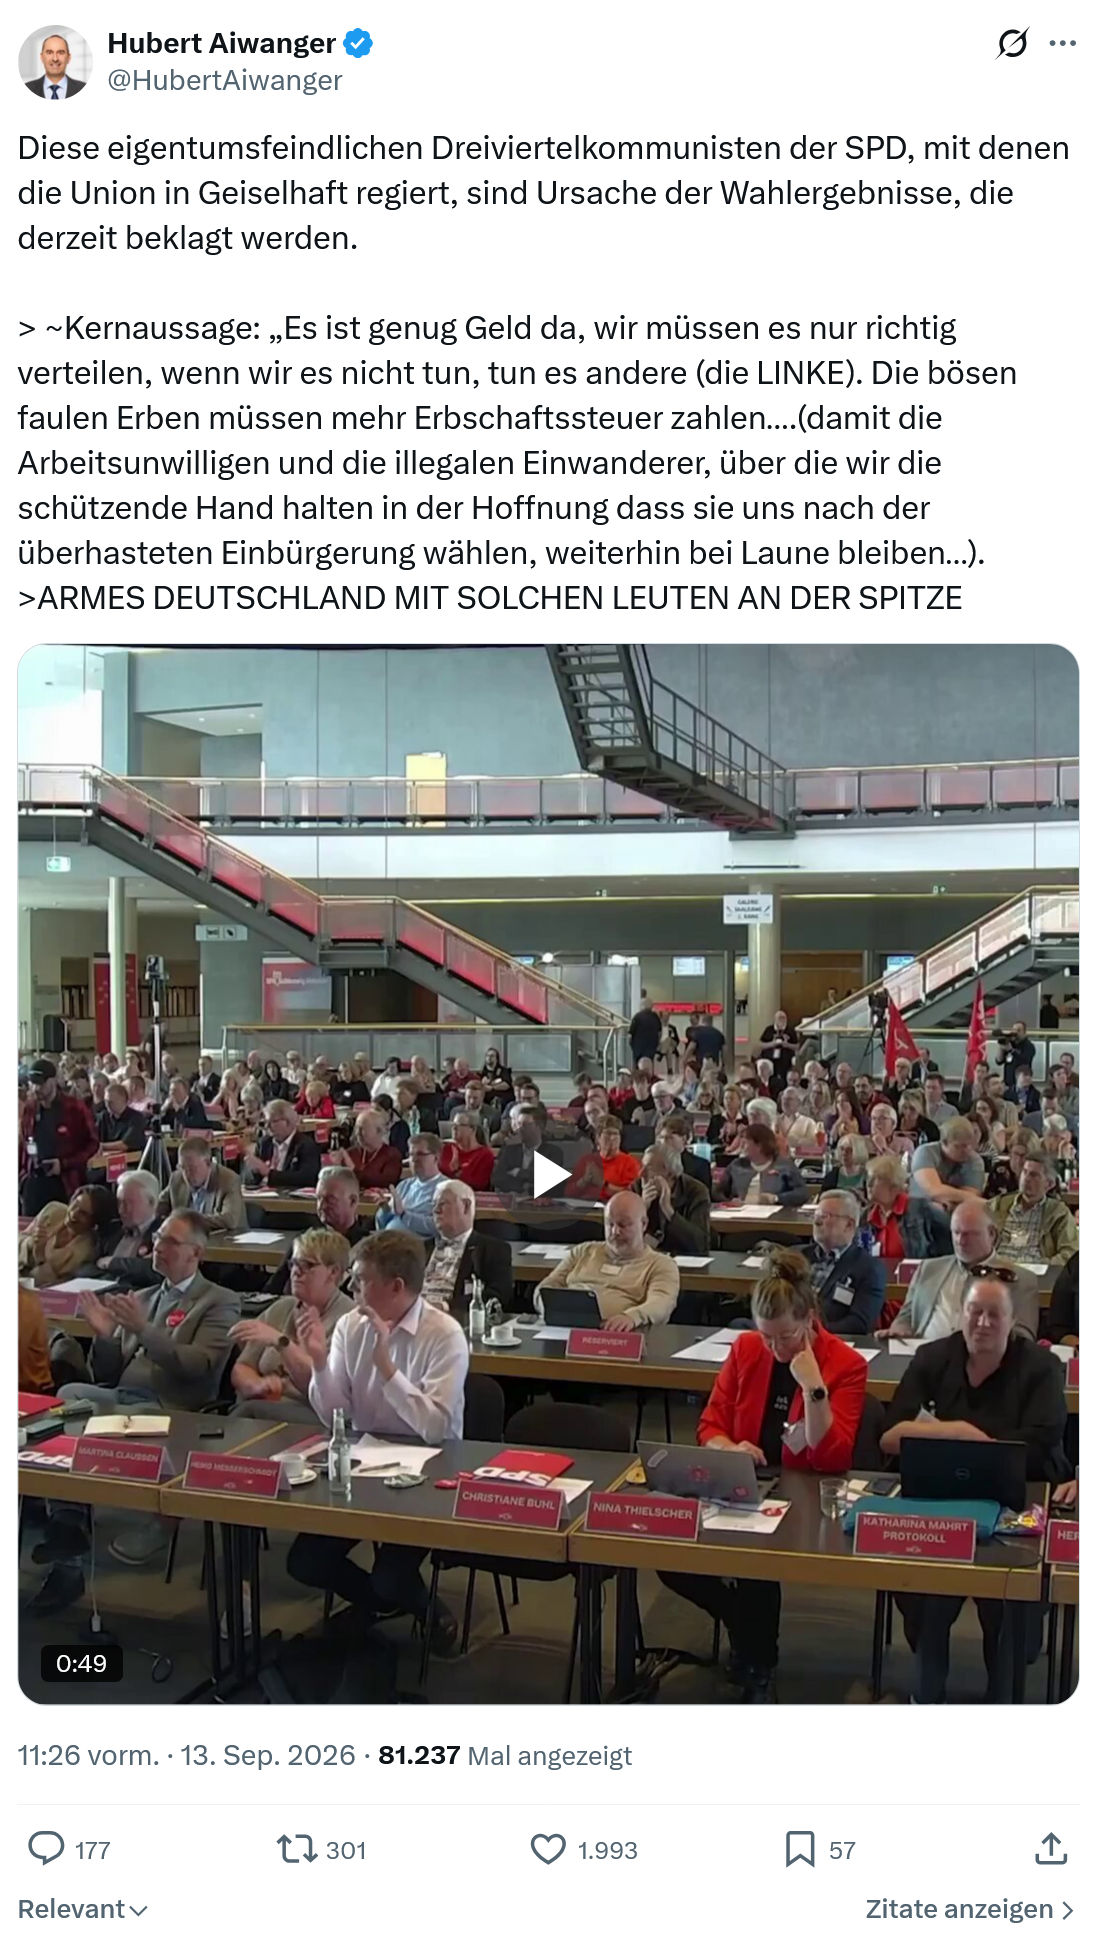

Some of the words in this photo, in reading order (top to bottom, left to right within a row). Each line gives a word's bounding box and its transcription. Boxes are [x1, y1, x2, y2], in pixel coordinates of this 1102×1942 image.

[78, 1446, 115, 1458] MARTINA
[115, 1450, 159, 1463] CLAUSSEN
[473, 1466, 553, 1488] SPD
[462, 1490, 526, 1507] CHRISTIANE
[526, 1498, 556, 1510] BUHL
[593, 1502, 622, 1513] NINA
[624, 1504, 693, 1520] THIELSCHER
[863, 1515, 926, 1530] KATHARINA
[928, 1520, 969, 1532] MAHRT
[882, 1530, 947, 1544] PROTOKOLL
